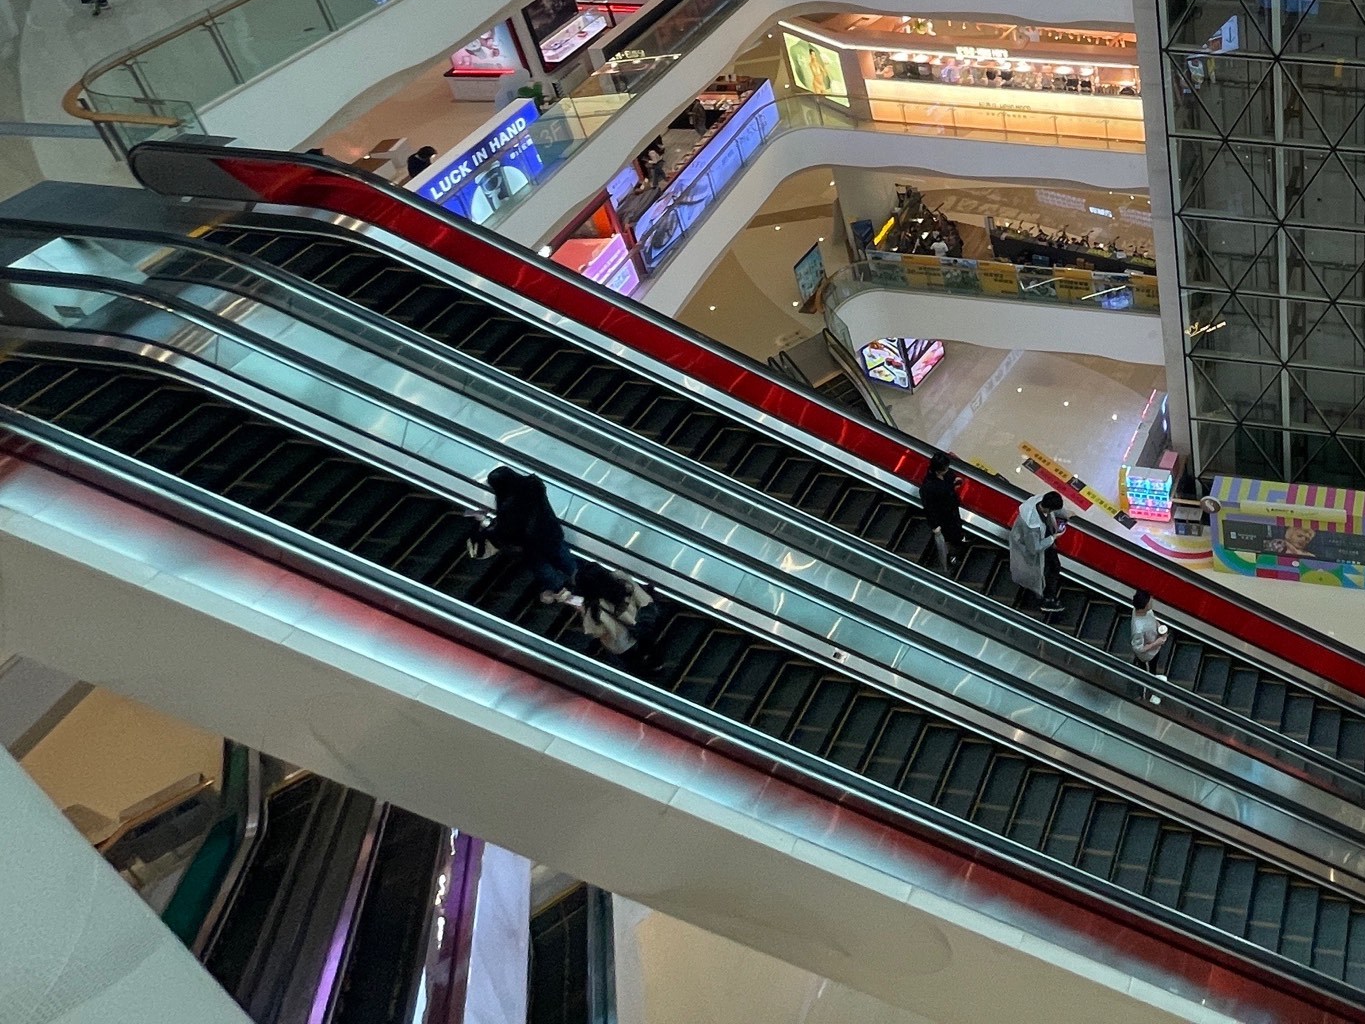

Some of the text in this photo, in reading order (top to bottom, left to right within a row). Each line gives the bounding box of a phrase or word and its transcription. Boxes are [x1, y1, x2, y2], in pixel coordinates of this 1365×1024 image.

[430, 160, 473, 201] LUCK
[471, 148, 489, 167] IN
[488, 117, 528, 154] HAND
